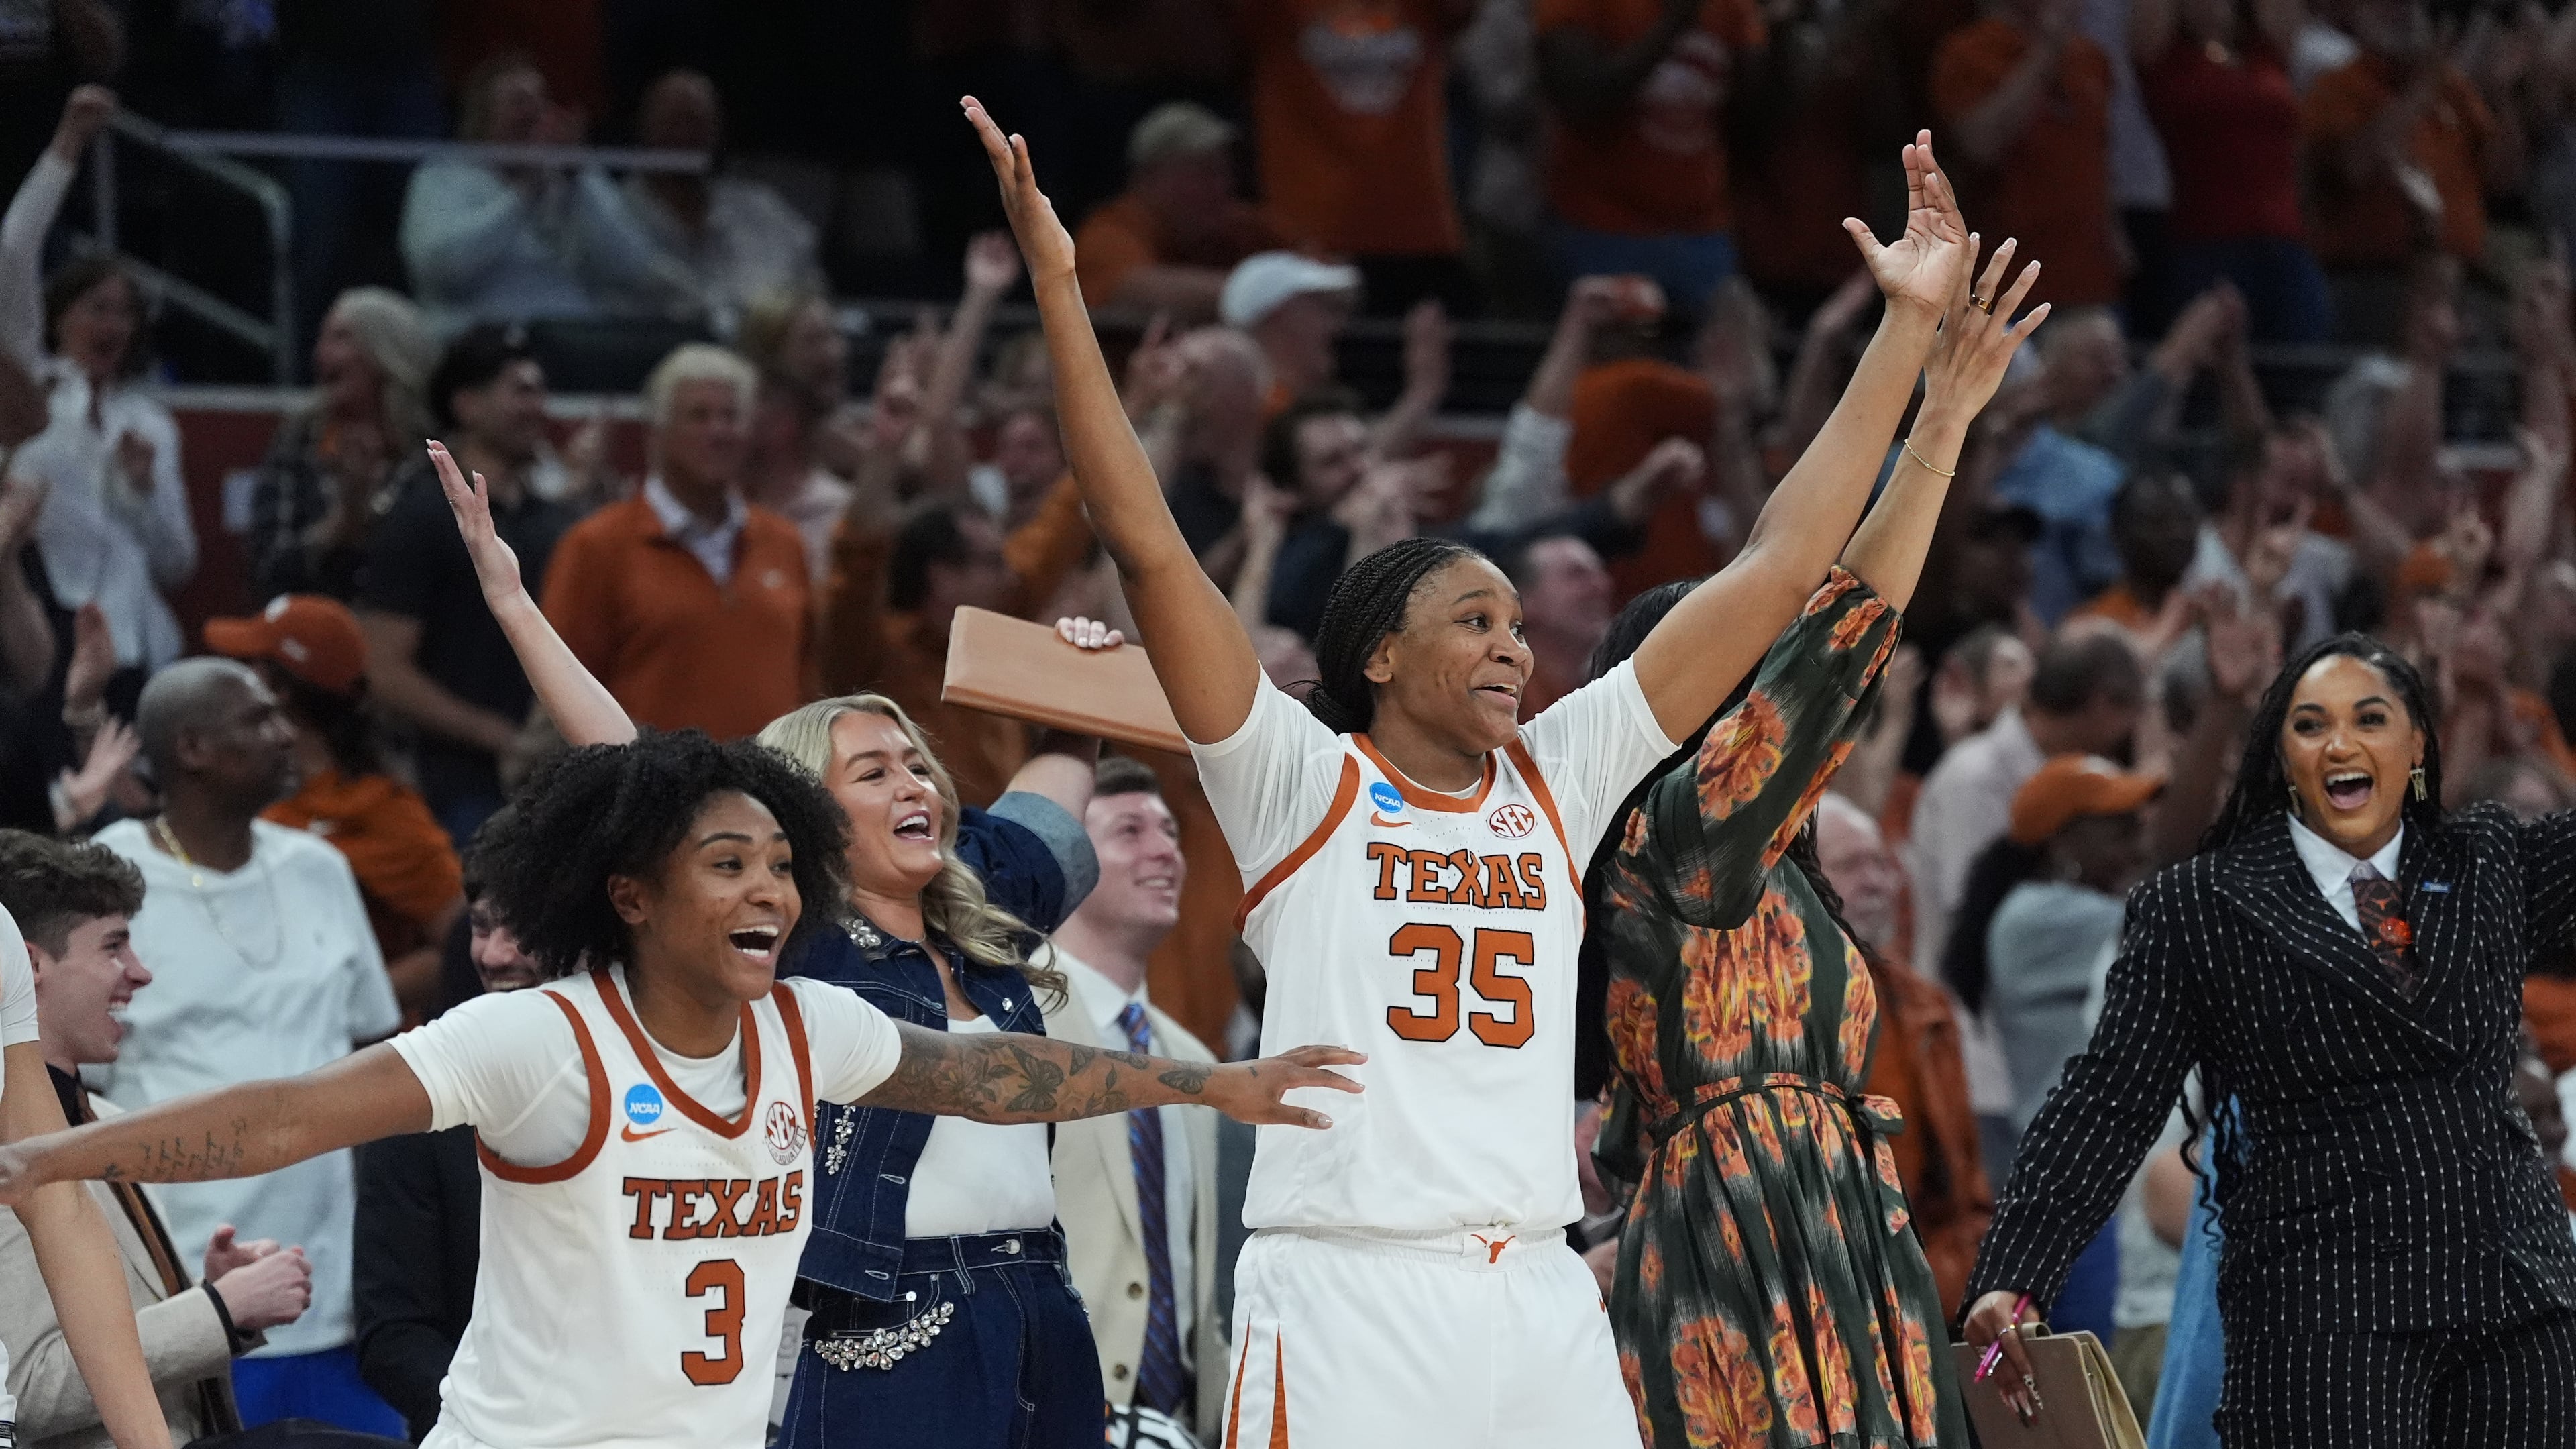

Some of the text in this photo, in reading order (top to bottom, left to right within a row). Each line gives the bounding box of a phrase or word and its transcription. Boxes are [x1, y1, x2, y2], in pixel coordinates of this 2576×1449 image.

[1375, 792, 1401, 808] NCAA
[1489, 804, 1534, 837] SEC
[1367, 842, 1546, 911] TEXAS
[1386, 922, 1535, 1049] 35
[629, 1102, 661, 1114] NCAA
[766, 1102, 796, 1150] SEC
[622, 1169, 803, 1241] TEXAS
[681, 1258, 745, 1386] 3
